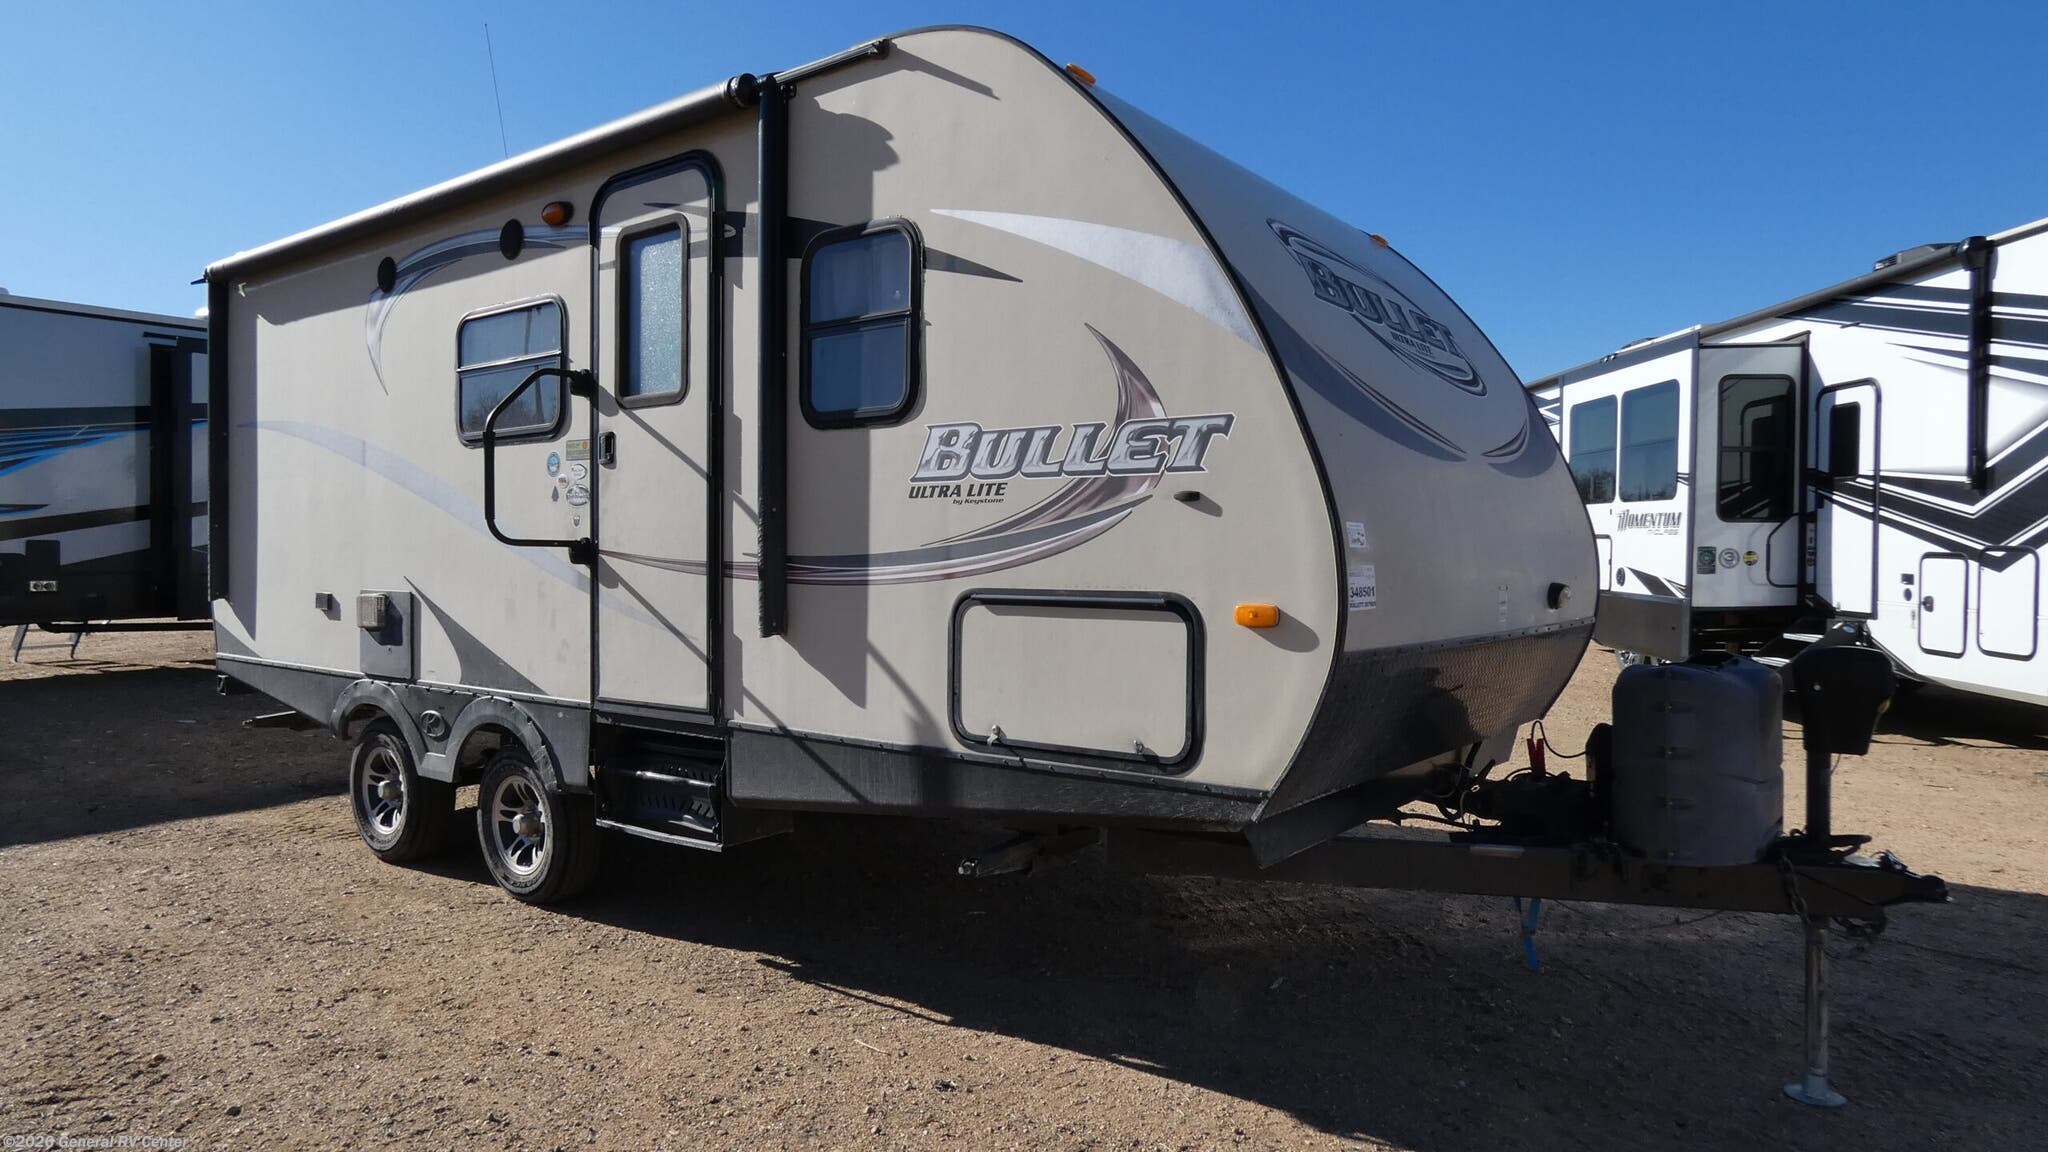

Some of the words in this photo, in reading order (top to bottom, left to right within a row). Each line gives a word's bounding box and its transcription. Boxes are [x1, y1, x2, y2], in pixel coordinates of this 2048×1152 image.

[1297, 252, 1462, 357] BULLET
[908, 412, 1236, 483] BULLET
[908, 485, 961, 499] ULTRA
[966, 482, 1009, 497] LITE
[1616, 509, 1682, 531] MOMENTUM
[1349, 585, 1375, 598] 348501
